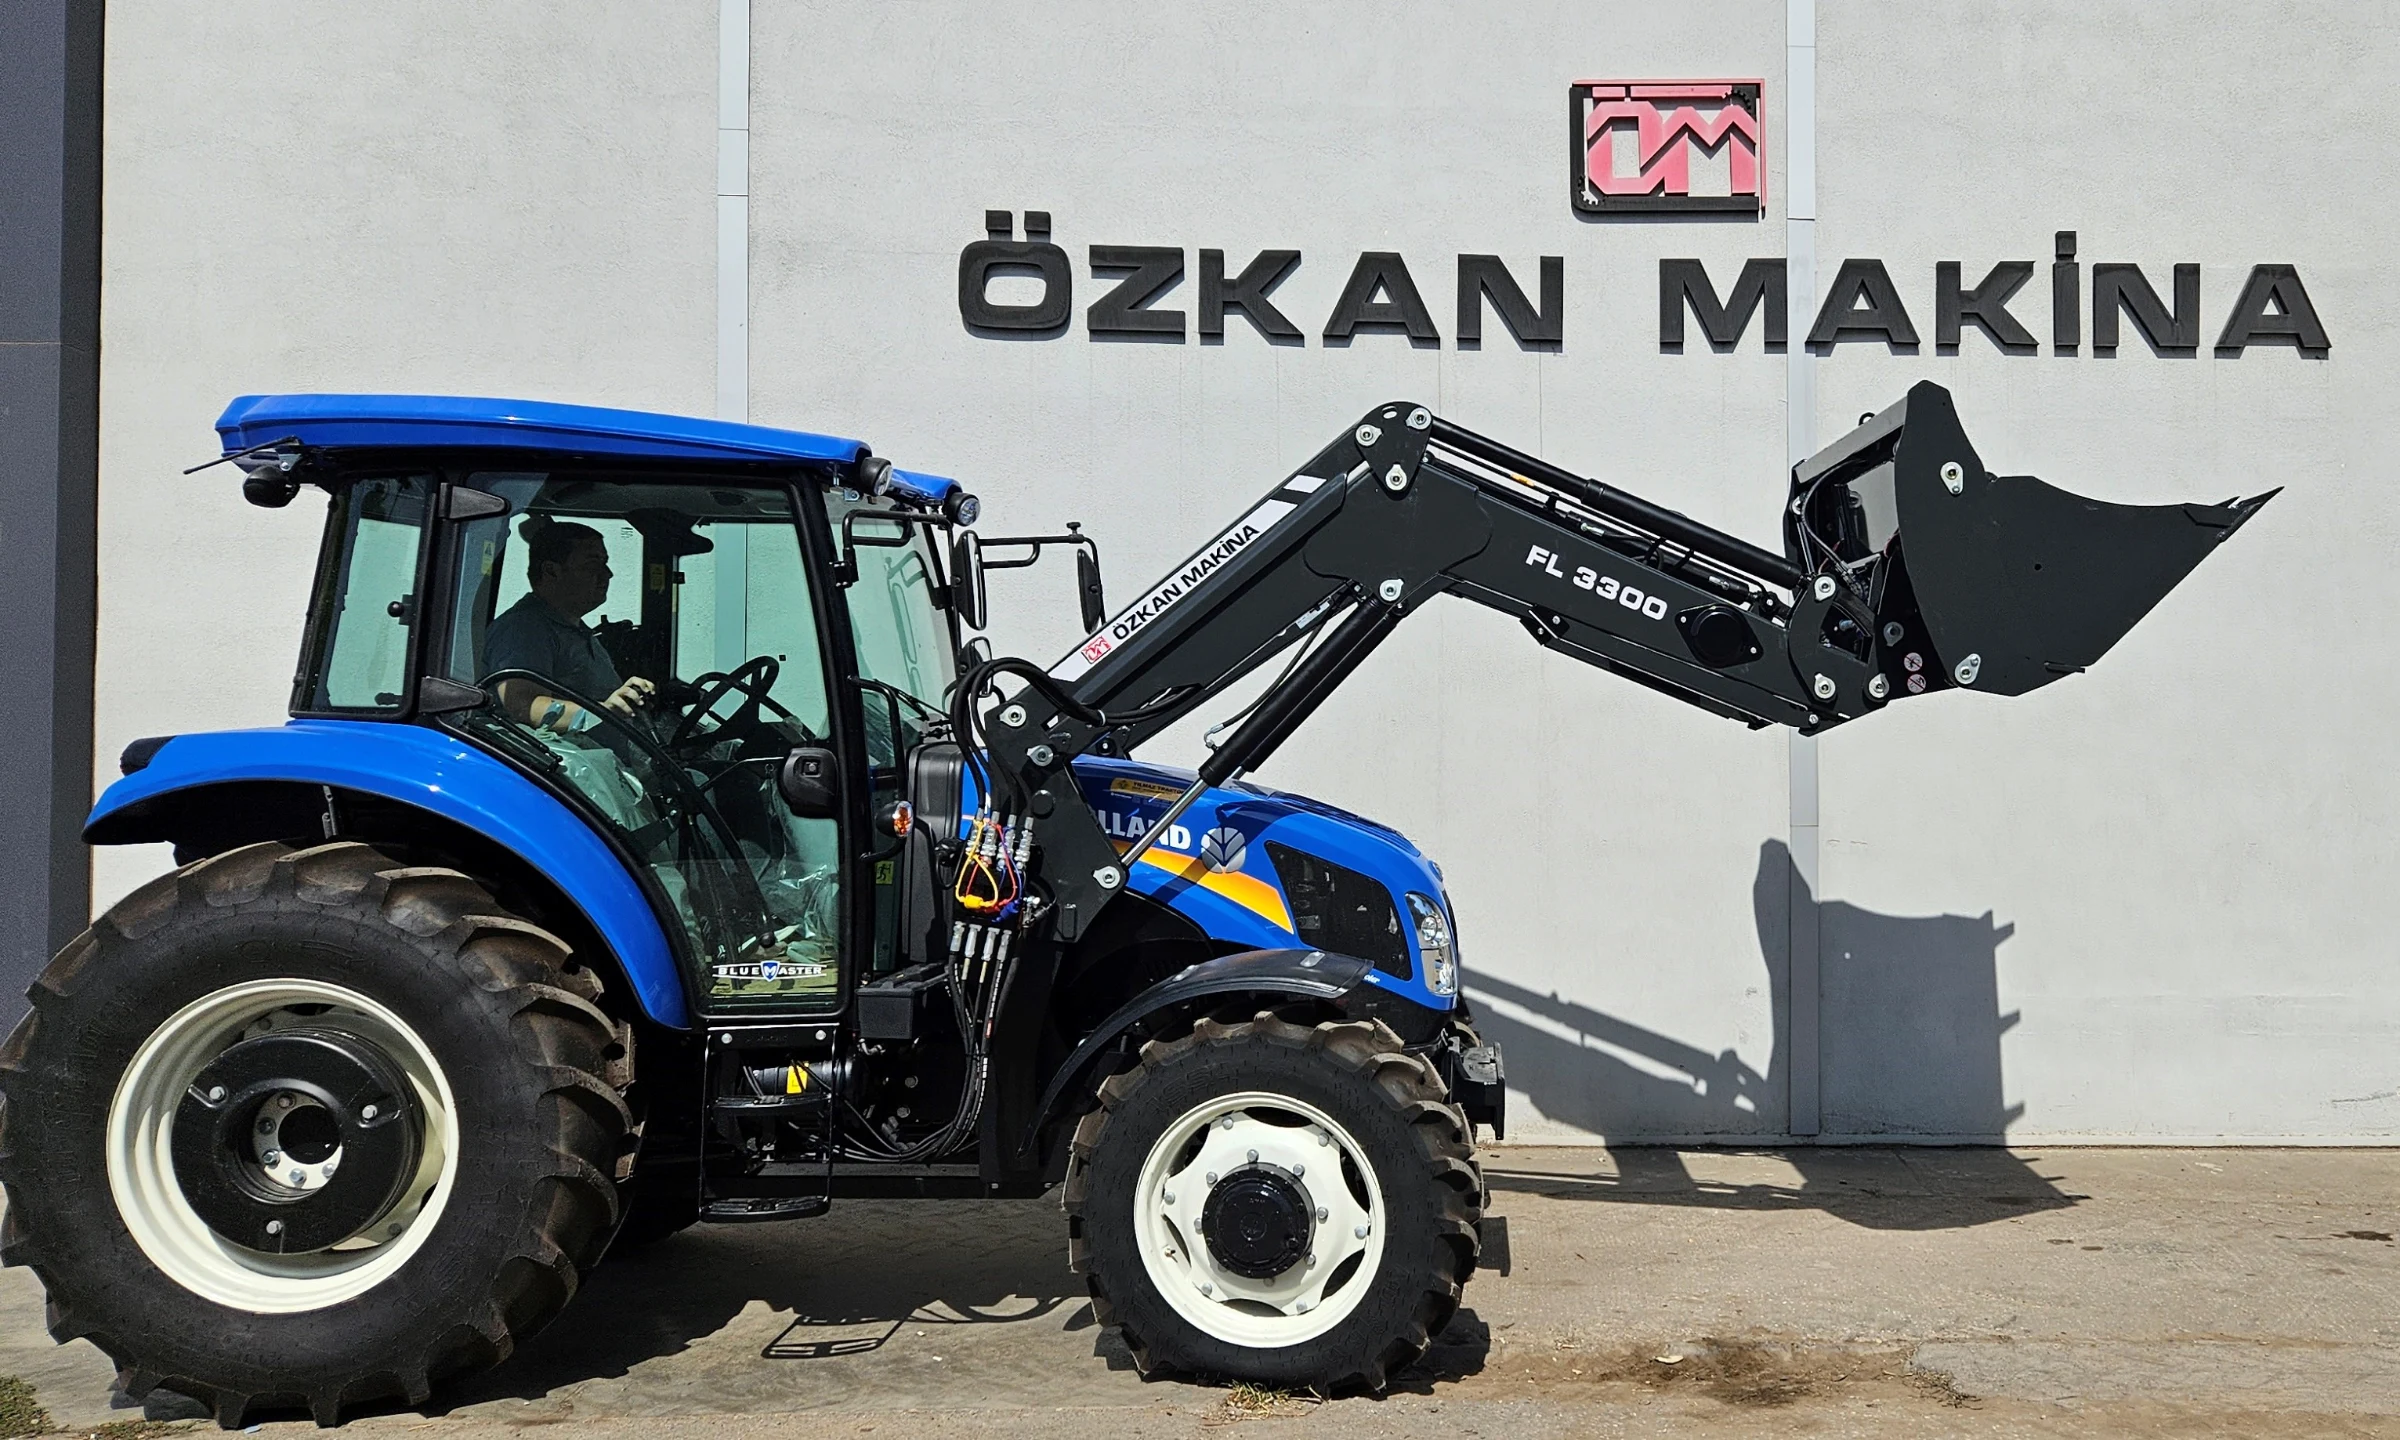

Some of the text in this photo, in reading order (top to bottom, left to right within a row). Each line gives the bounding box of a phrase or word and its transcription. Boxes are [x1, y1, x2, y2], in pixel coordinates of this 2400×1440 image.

[959, 210, 2332, 357] ÖZKAN MAKİNA
[1112, 583, 1183, 640] ÖZKAN
[1180, 525, 1260, 588] MAKİNA
[1525, 545, 1668, 621] FL 3300
